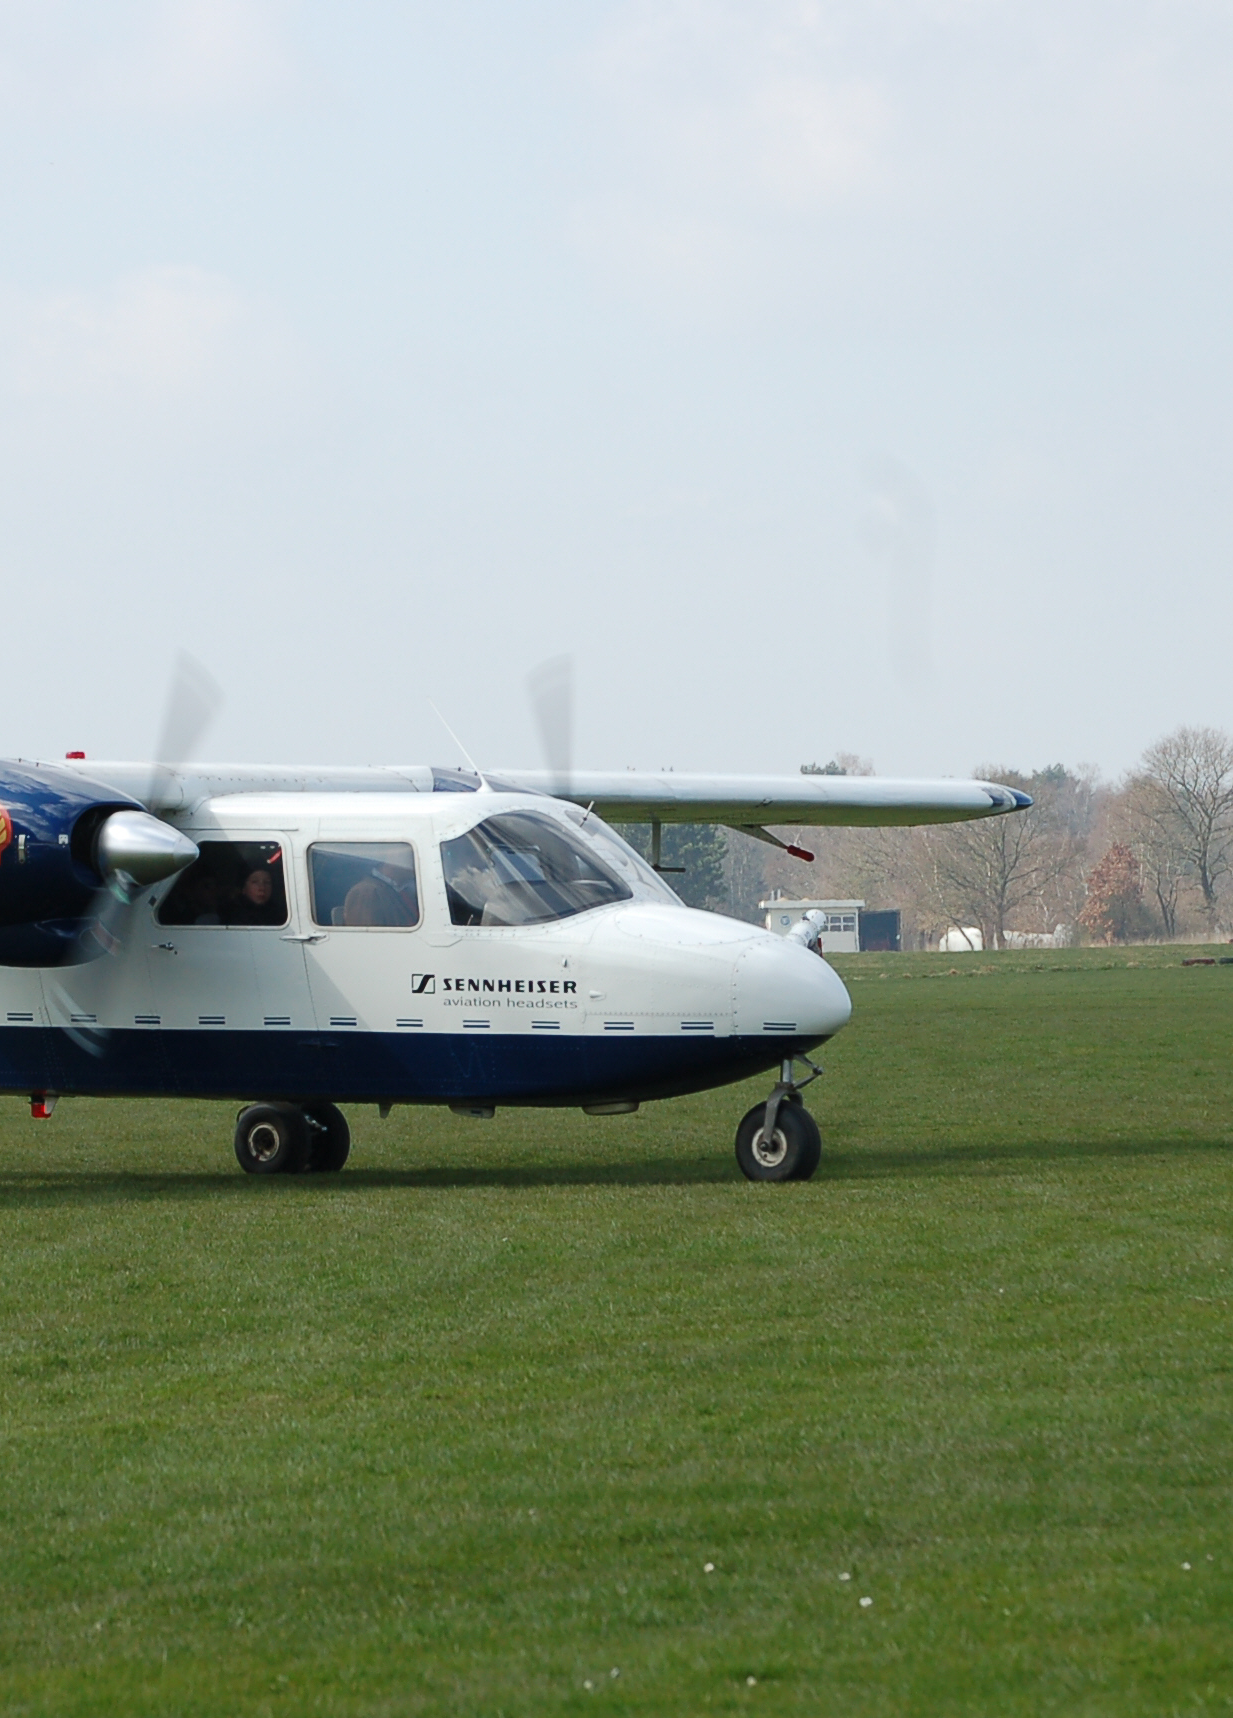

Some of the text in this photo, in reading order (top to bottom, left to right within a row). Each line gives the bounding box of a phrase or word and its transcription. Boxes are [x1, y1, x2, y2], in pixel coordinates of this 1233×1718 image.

[442, 977, 578, 994] SENNHEISER
[442, 996, 579, 1010] aviation headsets
